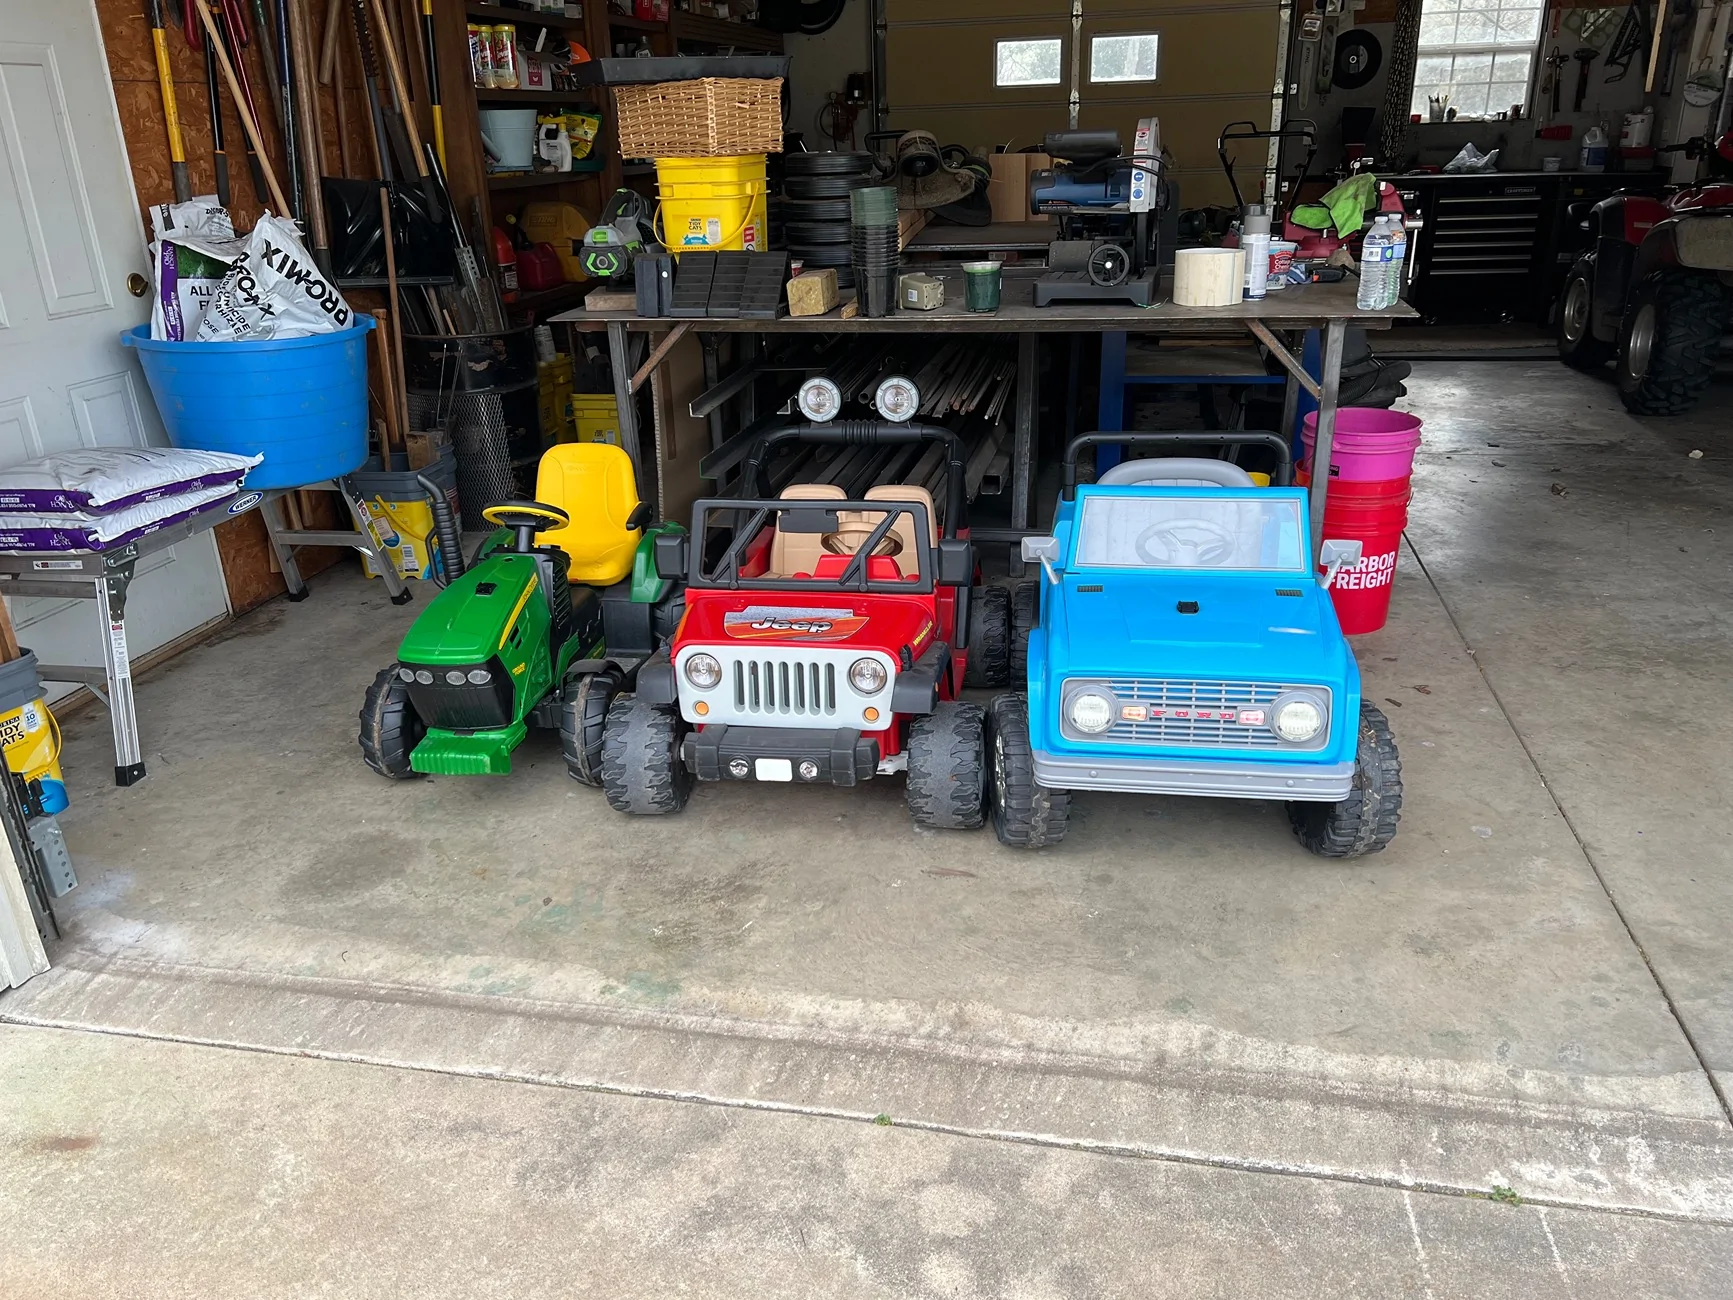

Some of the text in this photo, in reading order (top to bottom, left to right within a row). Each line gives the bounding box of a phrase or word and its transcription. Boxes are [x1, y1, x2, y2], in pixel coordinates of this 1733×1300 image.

[190, 286, 212, 296] ALL
[261, 239, 348, 327] PRO-MIX
[204, 318, 220, 334] OSE
[234, 495, 258, 512] WERNER
[750, 616, 832, 634] Jeep
[1152, 708, 1234, 720] FORD
